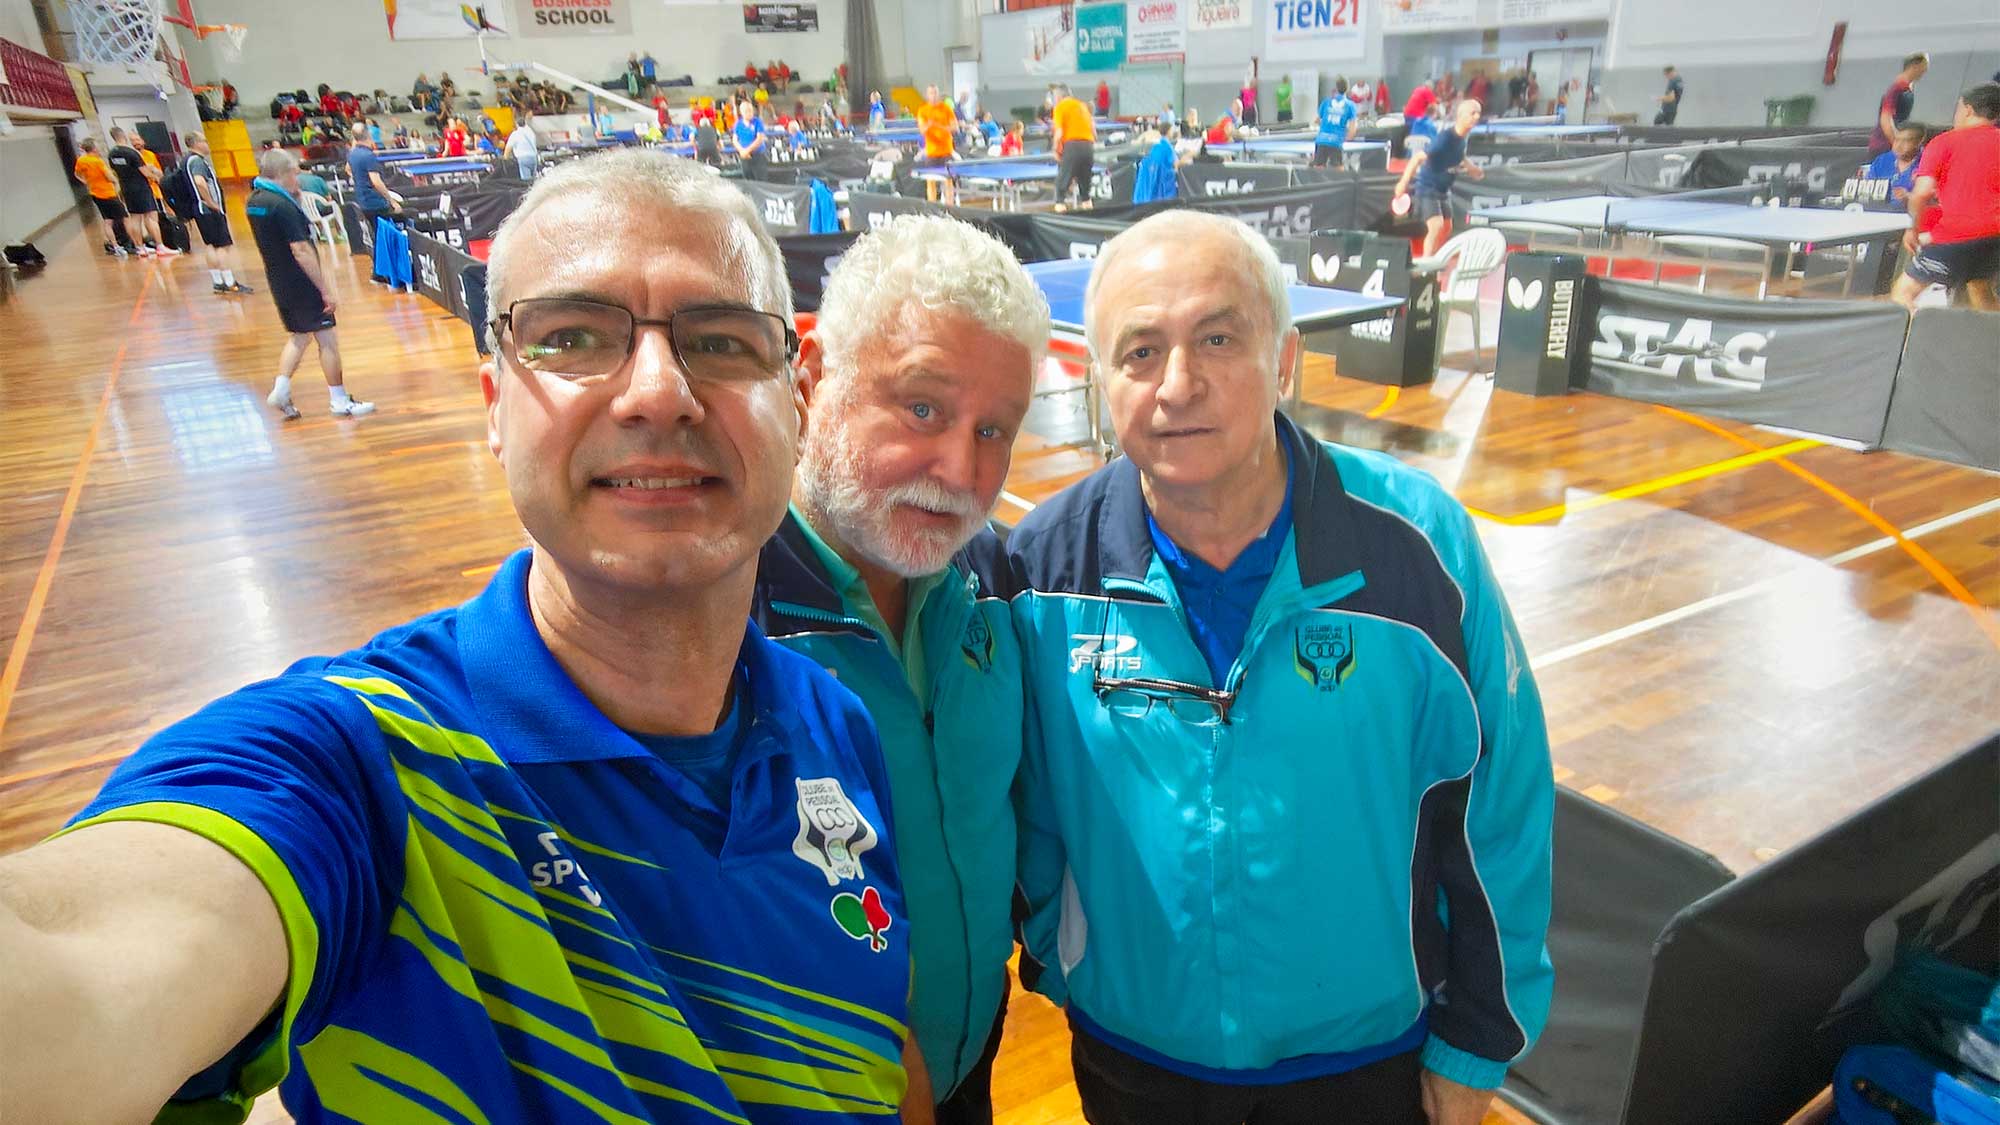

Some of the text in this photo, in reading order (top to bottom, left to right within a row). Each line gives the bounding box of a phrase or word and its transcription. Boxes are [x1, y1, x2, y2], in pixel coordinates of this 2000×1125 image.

[534, 9, 615, 25] SCHOOL
[1362, 268, 1385, 299] 4
[1416, 282, 1434, 314] 4
[1547, 279, 1575, 360] BUTTERFLY
[1591, 314, 1768, 392] STAG
